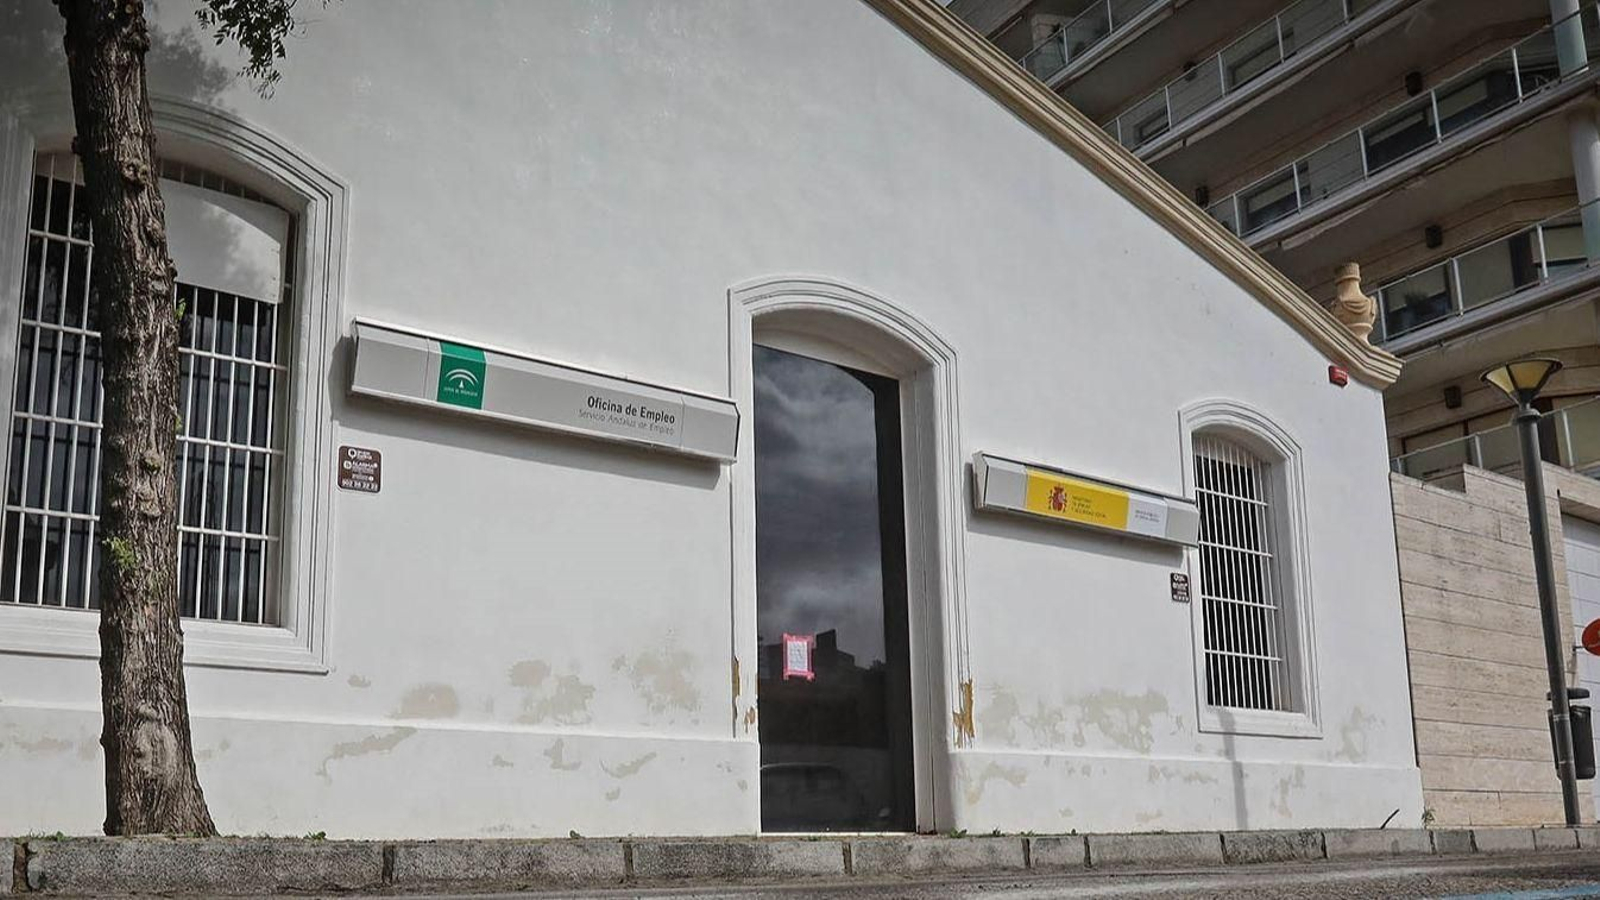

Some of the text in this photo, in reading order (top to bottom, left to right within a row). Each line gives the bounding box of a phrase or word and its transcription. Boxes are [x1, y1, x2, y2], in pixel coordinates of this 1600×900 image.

[579, 409, 606, 421] Servicio
[587, 396, 675, 424] Oficina de Empleo
